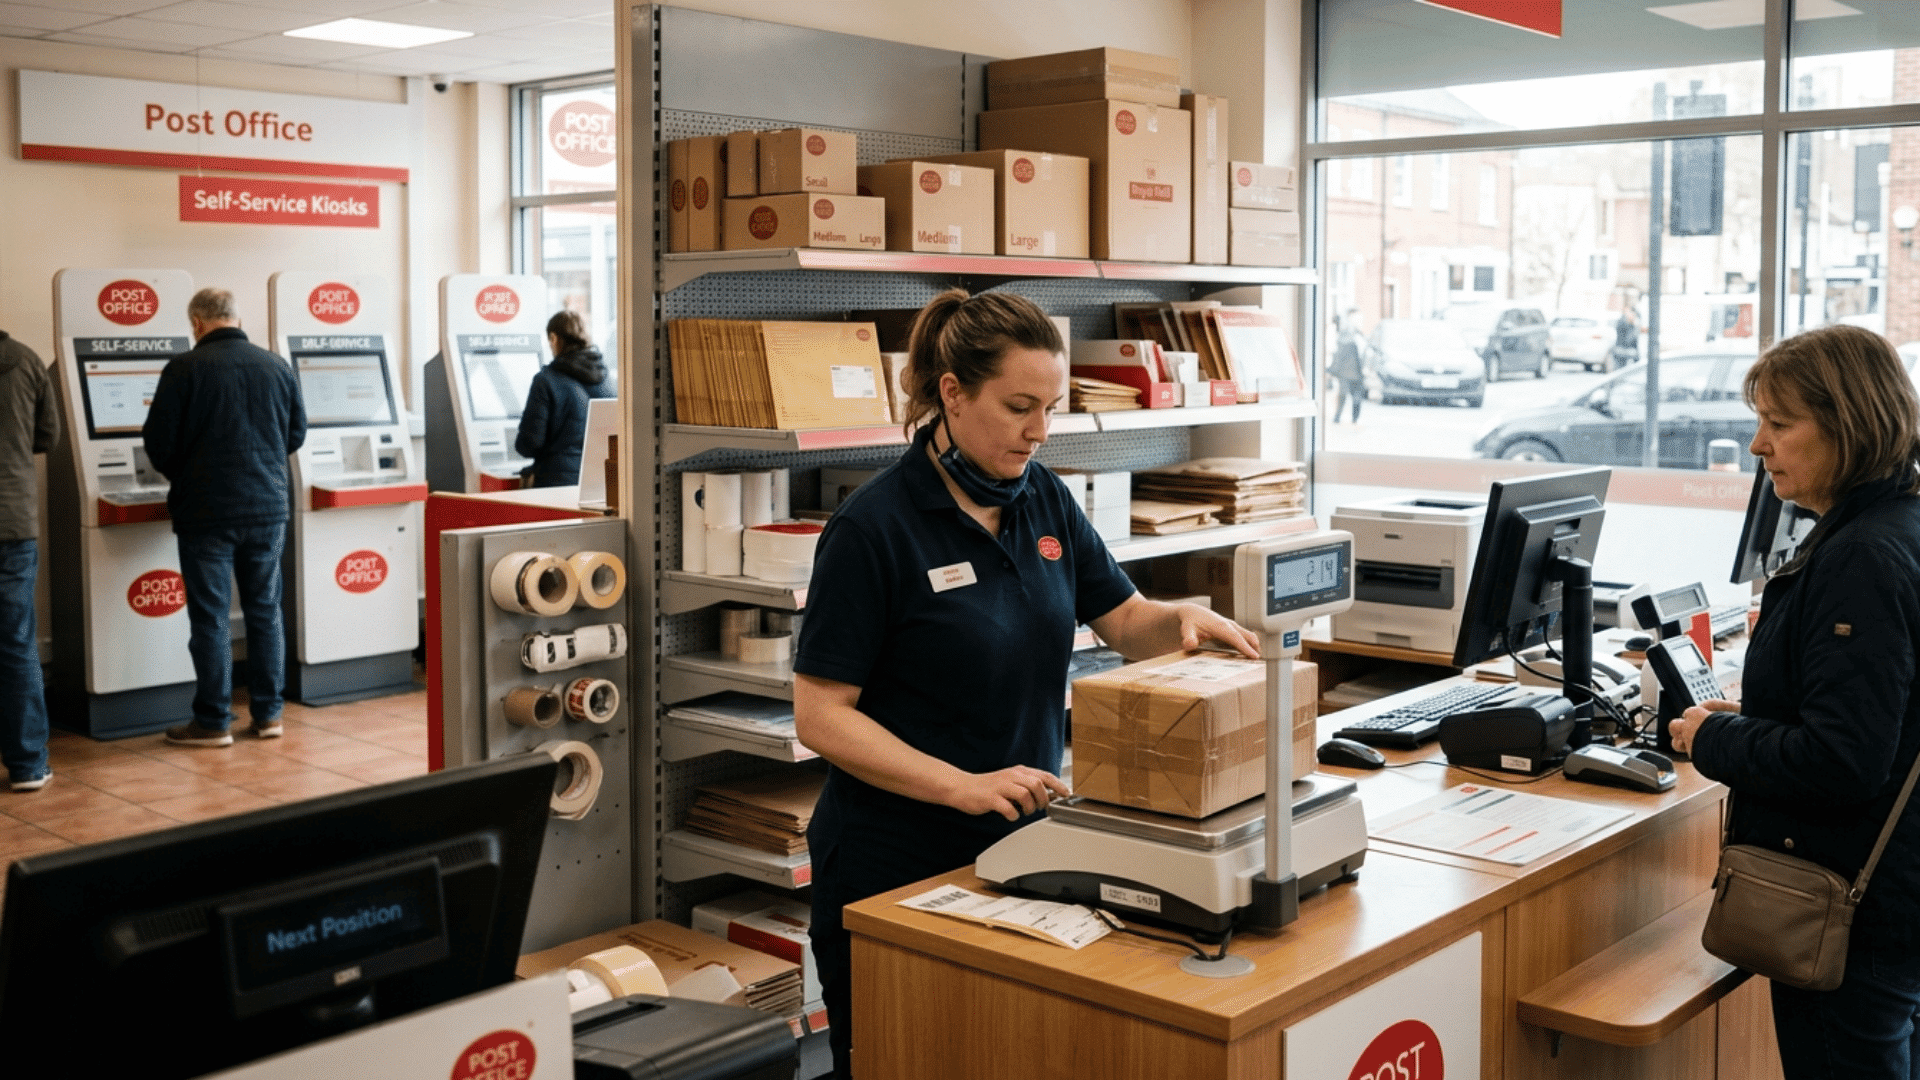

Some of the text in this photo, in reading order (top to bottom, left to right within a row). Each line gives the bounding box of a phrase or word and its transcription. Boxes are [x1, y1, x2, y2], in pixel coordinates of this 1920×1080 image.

[145, 103, 313, 141] Post Office
[565, 111, 611, 133] POST
[194, 189, 368, 217] Self-Service Kiosks
[1010, 233, 1039, 250] Large
[111, 288, 148, 301] POST
[103, 302, 152, 315] OFFICE
[91, 339, 174, 351] SELF-SERVICE
[141, 577, 179, 594] POST
[267, 903, 403, 953] Next Position
[468, 1040, 520, 1073] POST
[1360, 1041, 1426, 1080] OST
